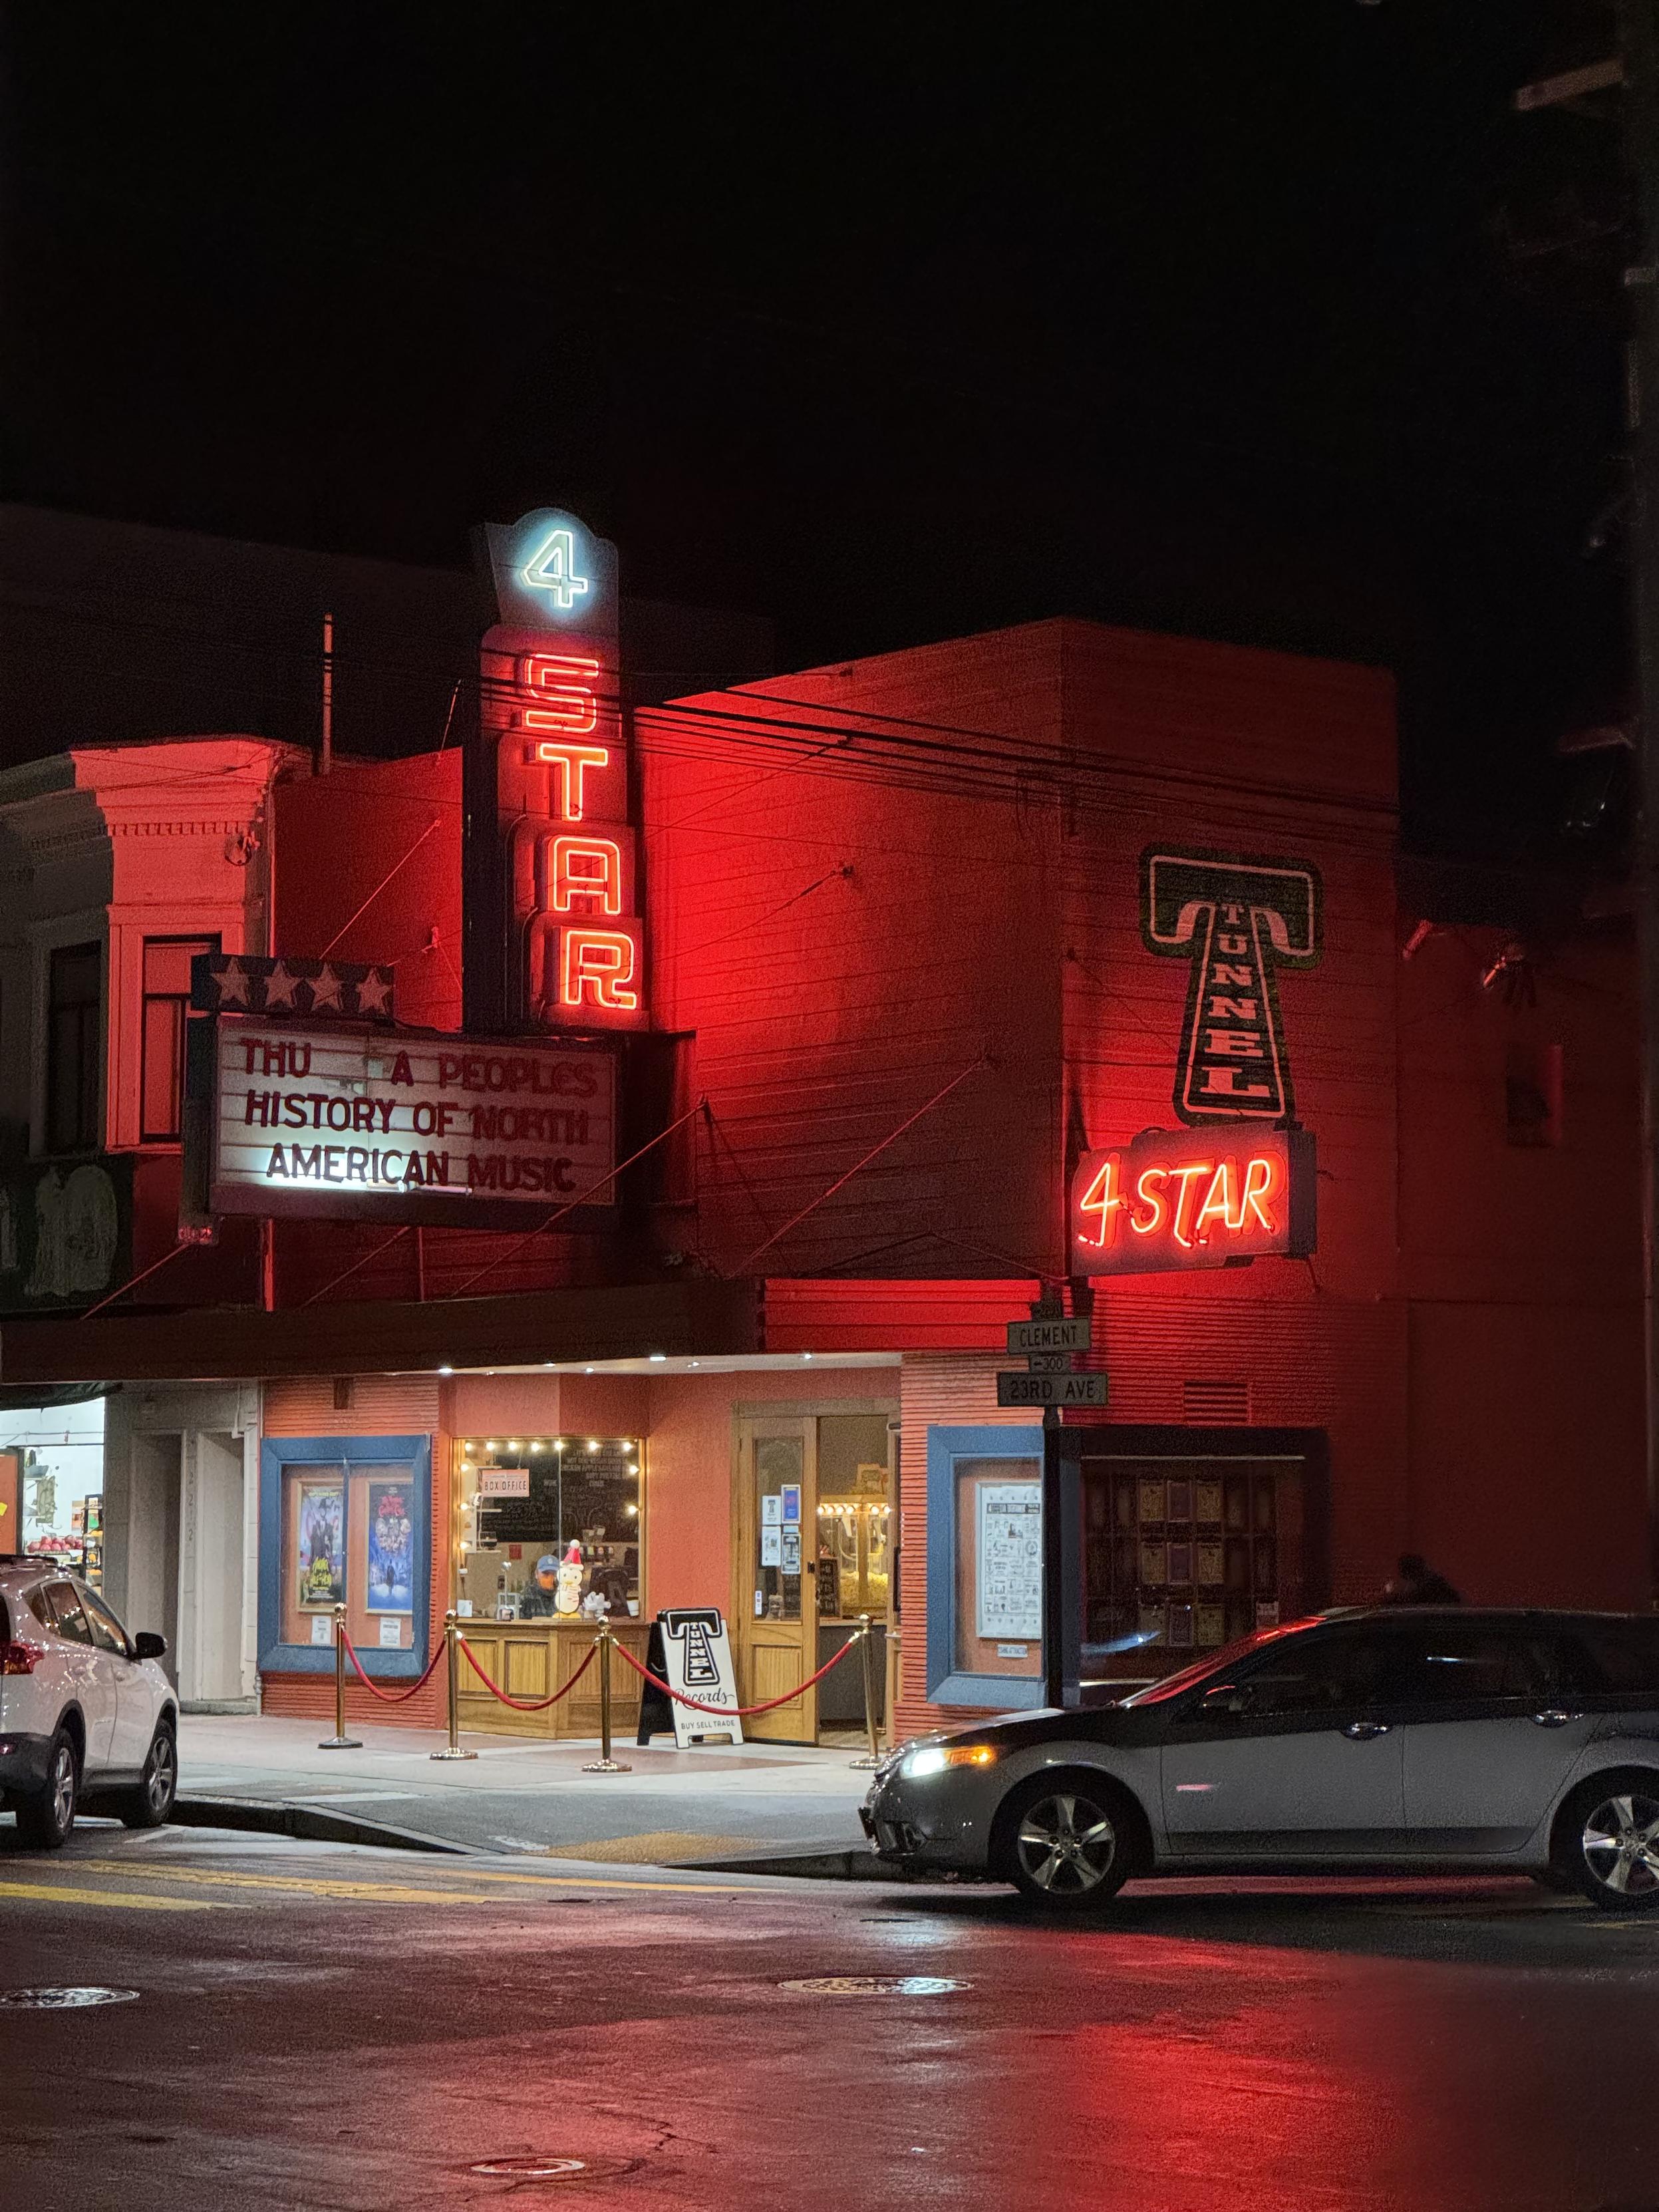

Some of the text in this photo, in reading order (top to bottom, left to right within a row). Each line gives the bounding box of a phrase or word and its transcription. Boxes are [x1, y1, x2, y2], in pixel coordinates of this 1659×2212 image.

[523, 529, 637, 1010] 4 STAR
[1201, 904, 1270, 1098] TUNNEL
[240, 1038, 597, 1098] THU A PEOPLES
[245, 1089, 589, 1145] HISTORY OF NORTH
[266, 1142, 577, 1192] AMERICAN MUSIC
[1078, 1150, 1286, 1249] 4 STAR
[1019, 1325, 1077, 1346] CLEMENT
[1010, 1380, 1095, 1399] 23RD AVE
[485, 1480, 527, 1490] BOX OFFICE
[689, 1621, 713, 1679] TUNNEL
